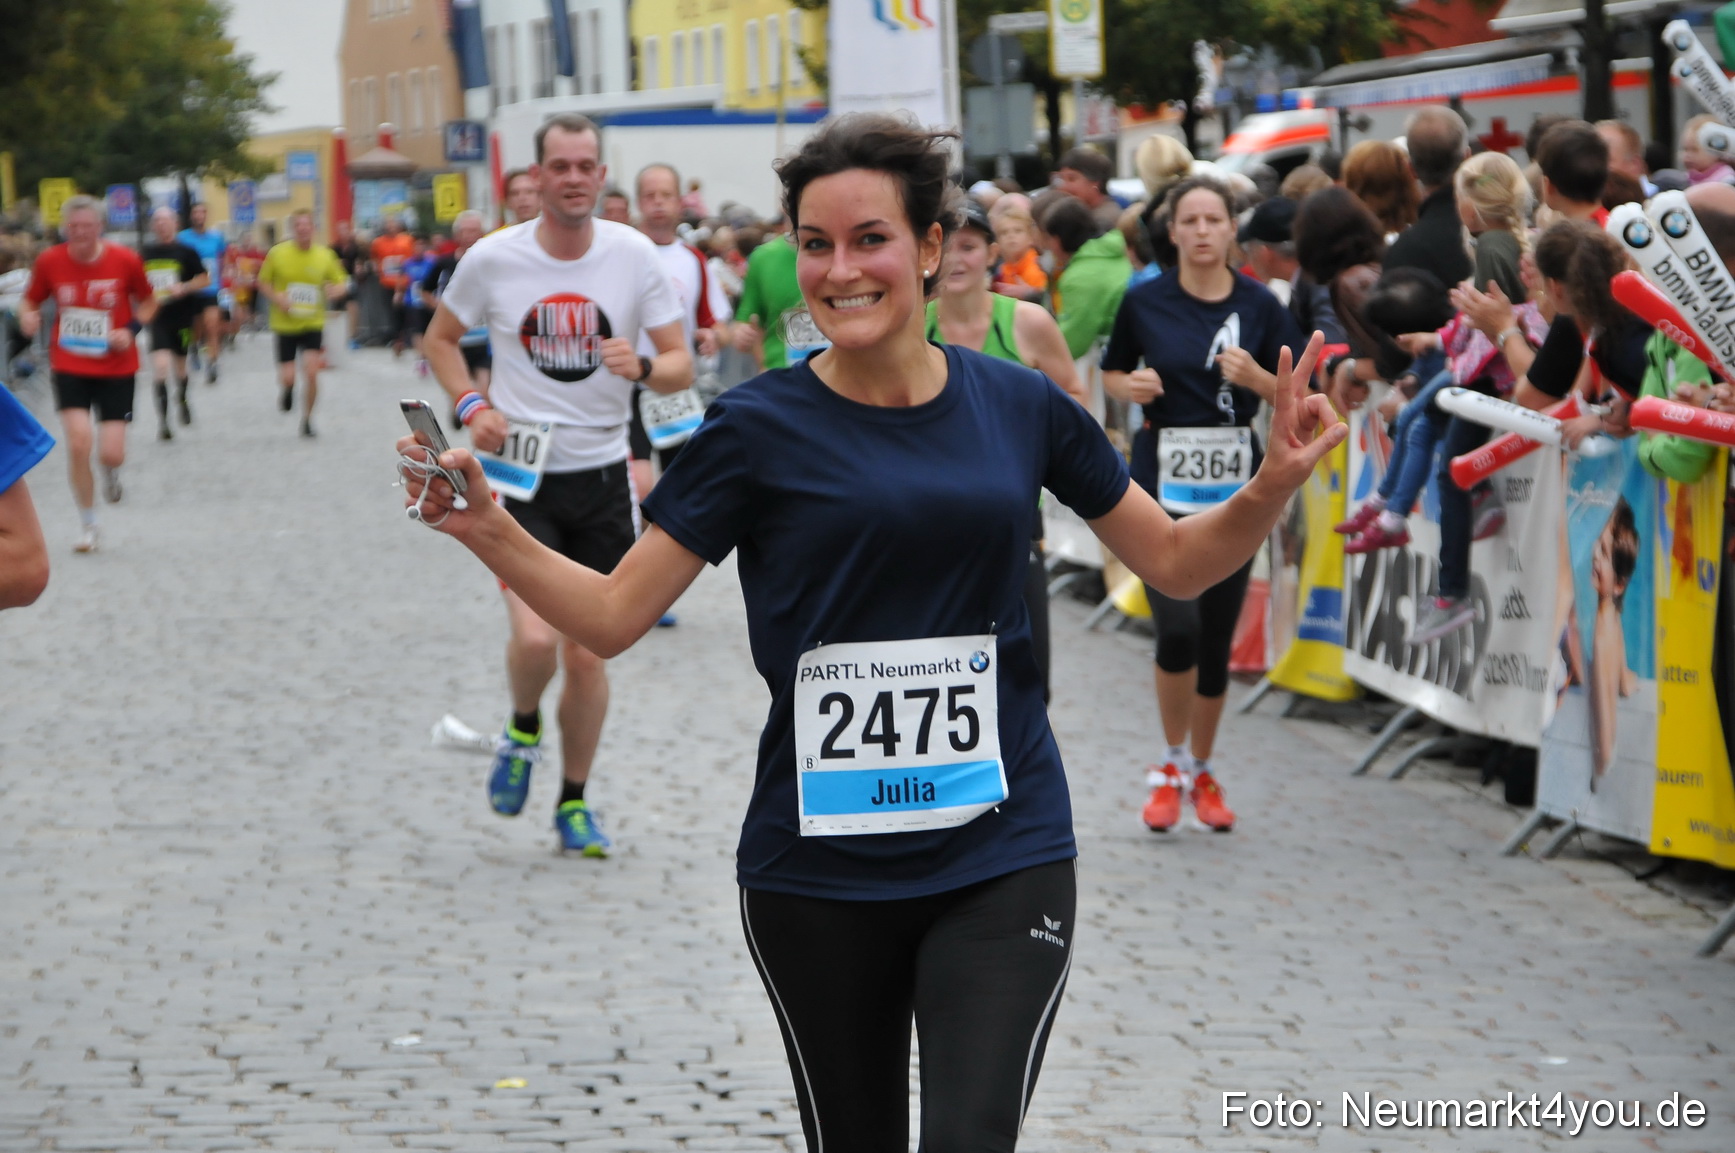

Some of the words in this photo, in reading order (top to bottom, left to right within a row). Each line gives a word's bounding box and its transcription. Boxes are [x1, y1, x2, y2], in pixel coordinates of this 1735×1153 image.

[1685, 247, 1735, 314] BMW
[535, 301, 600, 336] TOKYO
[1170, 449, 1242, 479] 2364
[801, 663, 865, 682] PARTL
[871, 657, 961, 679] Neumarkt
[818, 684, 980, 759] 2475
[806, 758, 813, 769] B
[871, 777, 936, 806] Julia
[1030, 928, 1064, 947] erima
